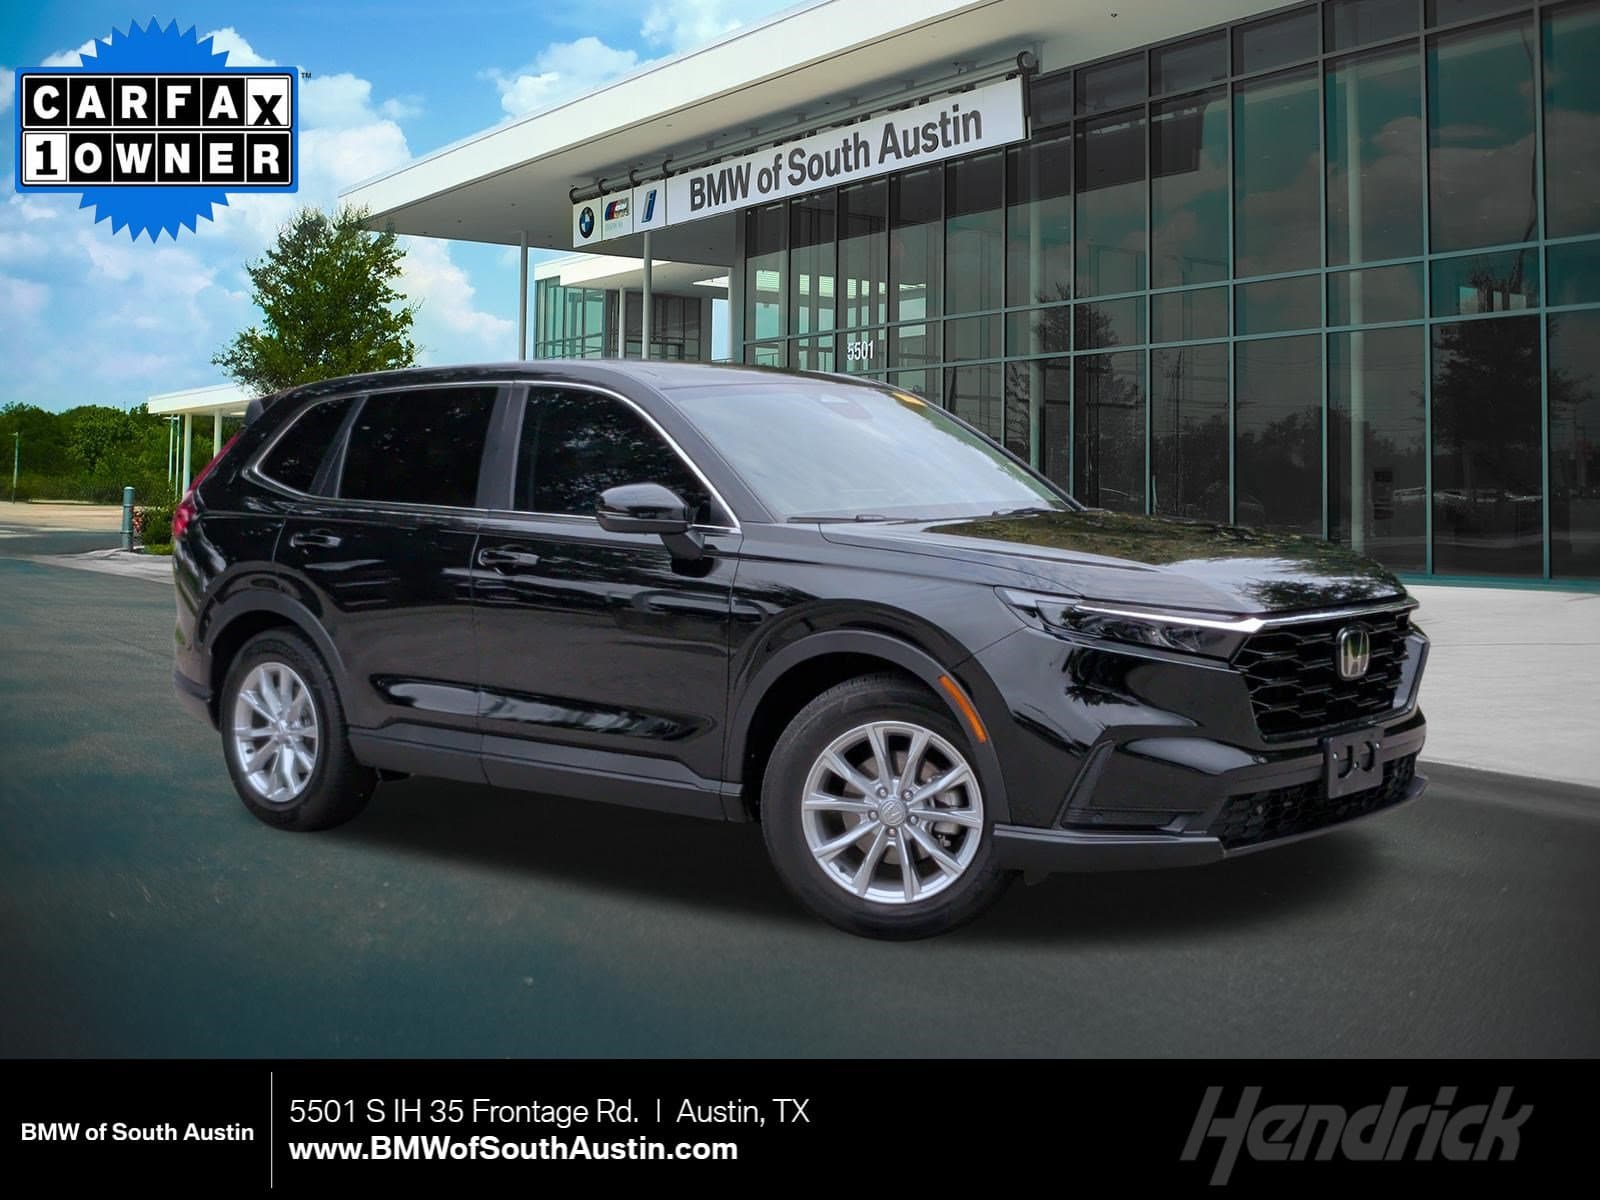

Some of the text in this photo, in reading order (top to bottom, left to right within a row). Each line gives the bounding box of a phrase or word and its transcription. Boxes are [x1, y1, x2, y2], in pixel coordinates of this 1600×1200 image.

[690, 104, 982, 211] BMW of South Austin
[847, 340, 874, 360] 5501
